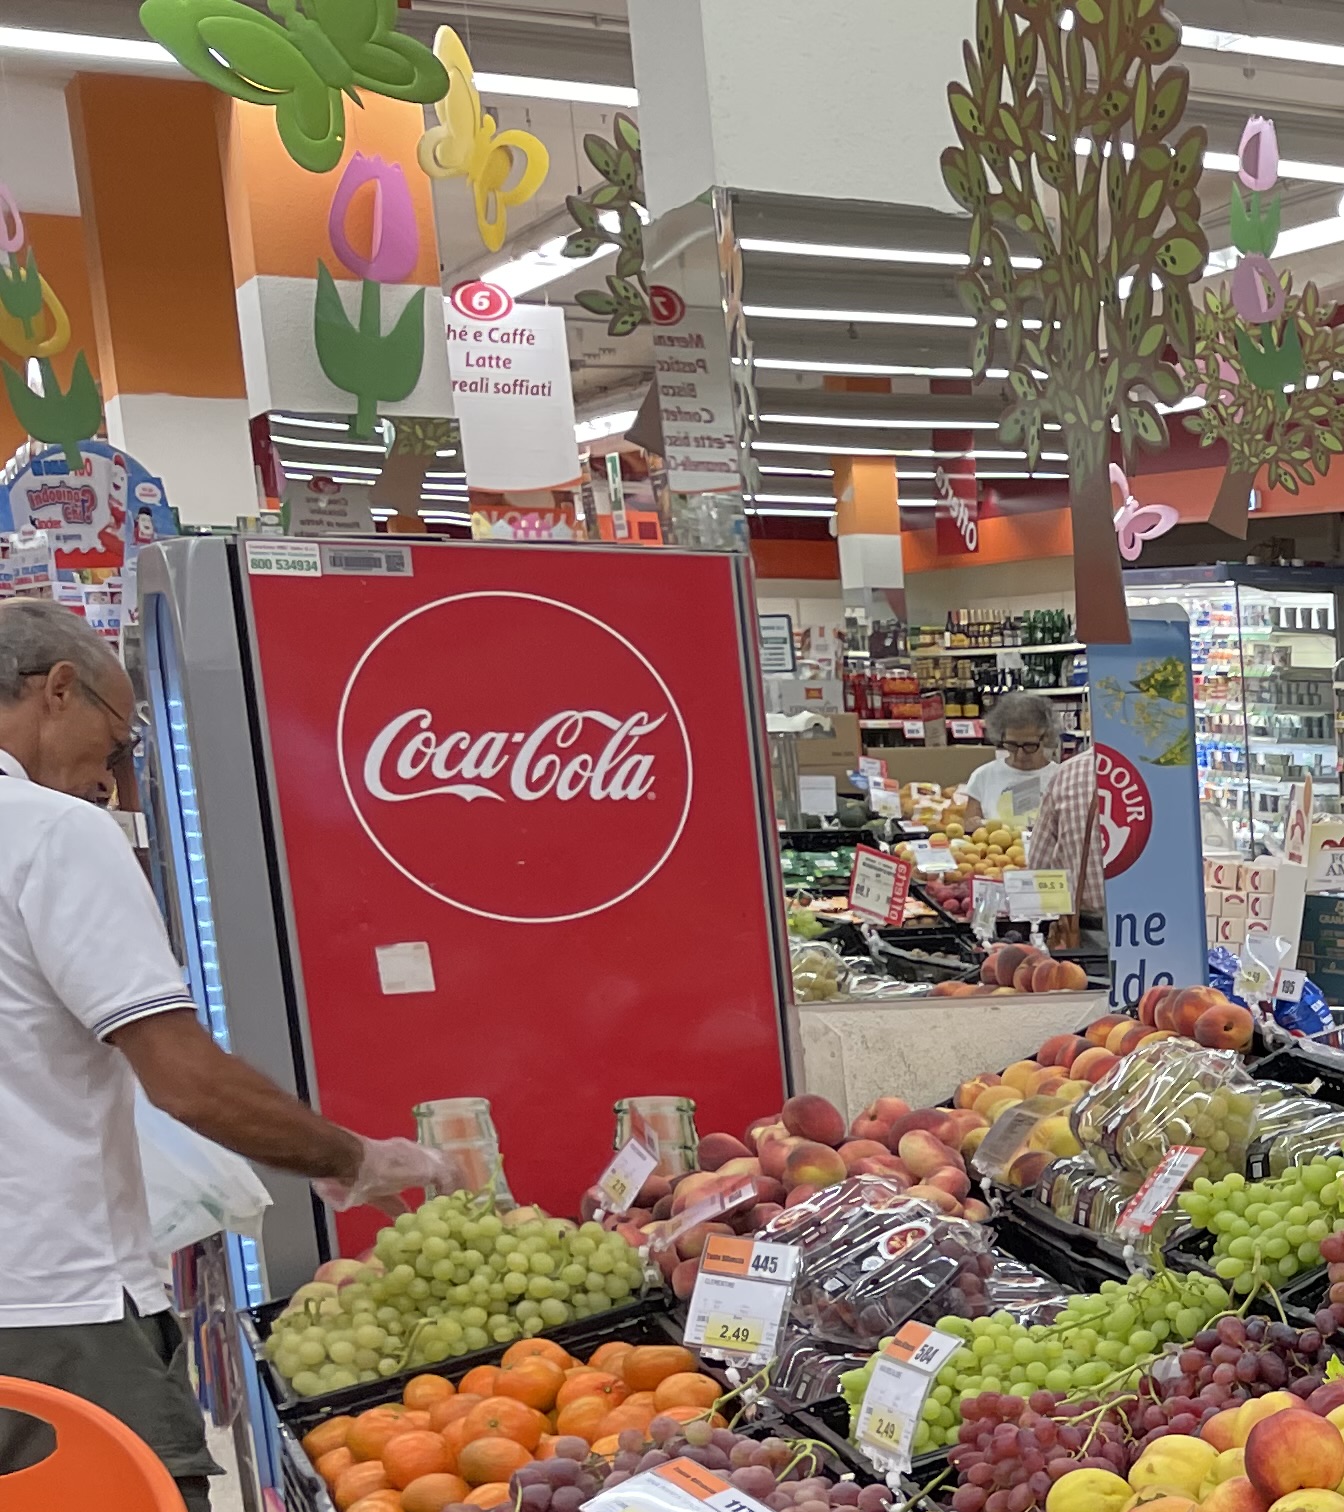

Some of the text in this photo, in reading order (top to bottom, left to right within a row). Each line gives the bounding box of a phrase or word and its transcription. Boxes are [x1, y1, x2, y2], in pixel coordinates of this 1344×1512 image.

[471, 290, 490, 311] 6
[446, 323, 535, 346] hé e Caffè
[465, 351, 512, 370] Latte
[452, 377, 552, 397] reali soffiati
[250, 558, 318, 572] 800 534934
[364, 708, 669, 803] Coca-Cola
[1114, 911, 1167, 948] ne
[751, 1254, 779, 1274] 445
[719, 1324, 750, 1342] 2,49
[875, 1418, 896, 1440] 2,49
